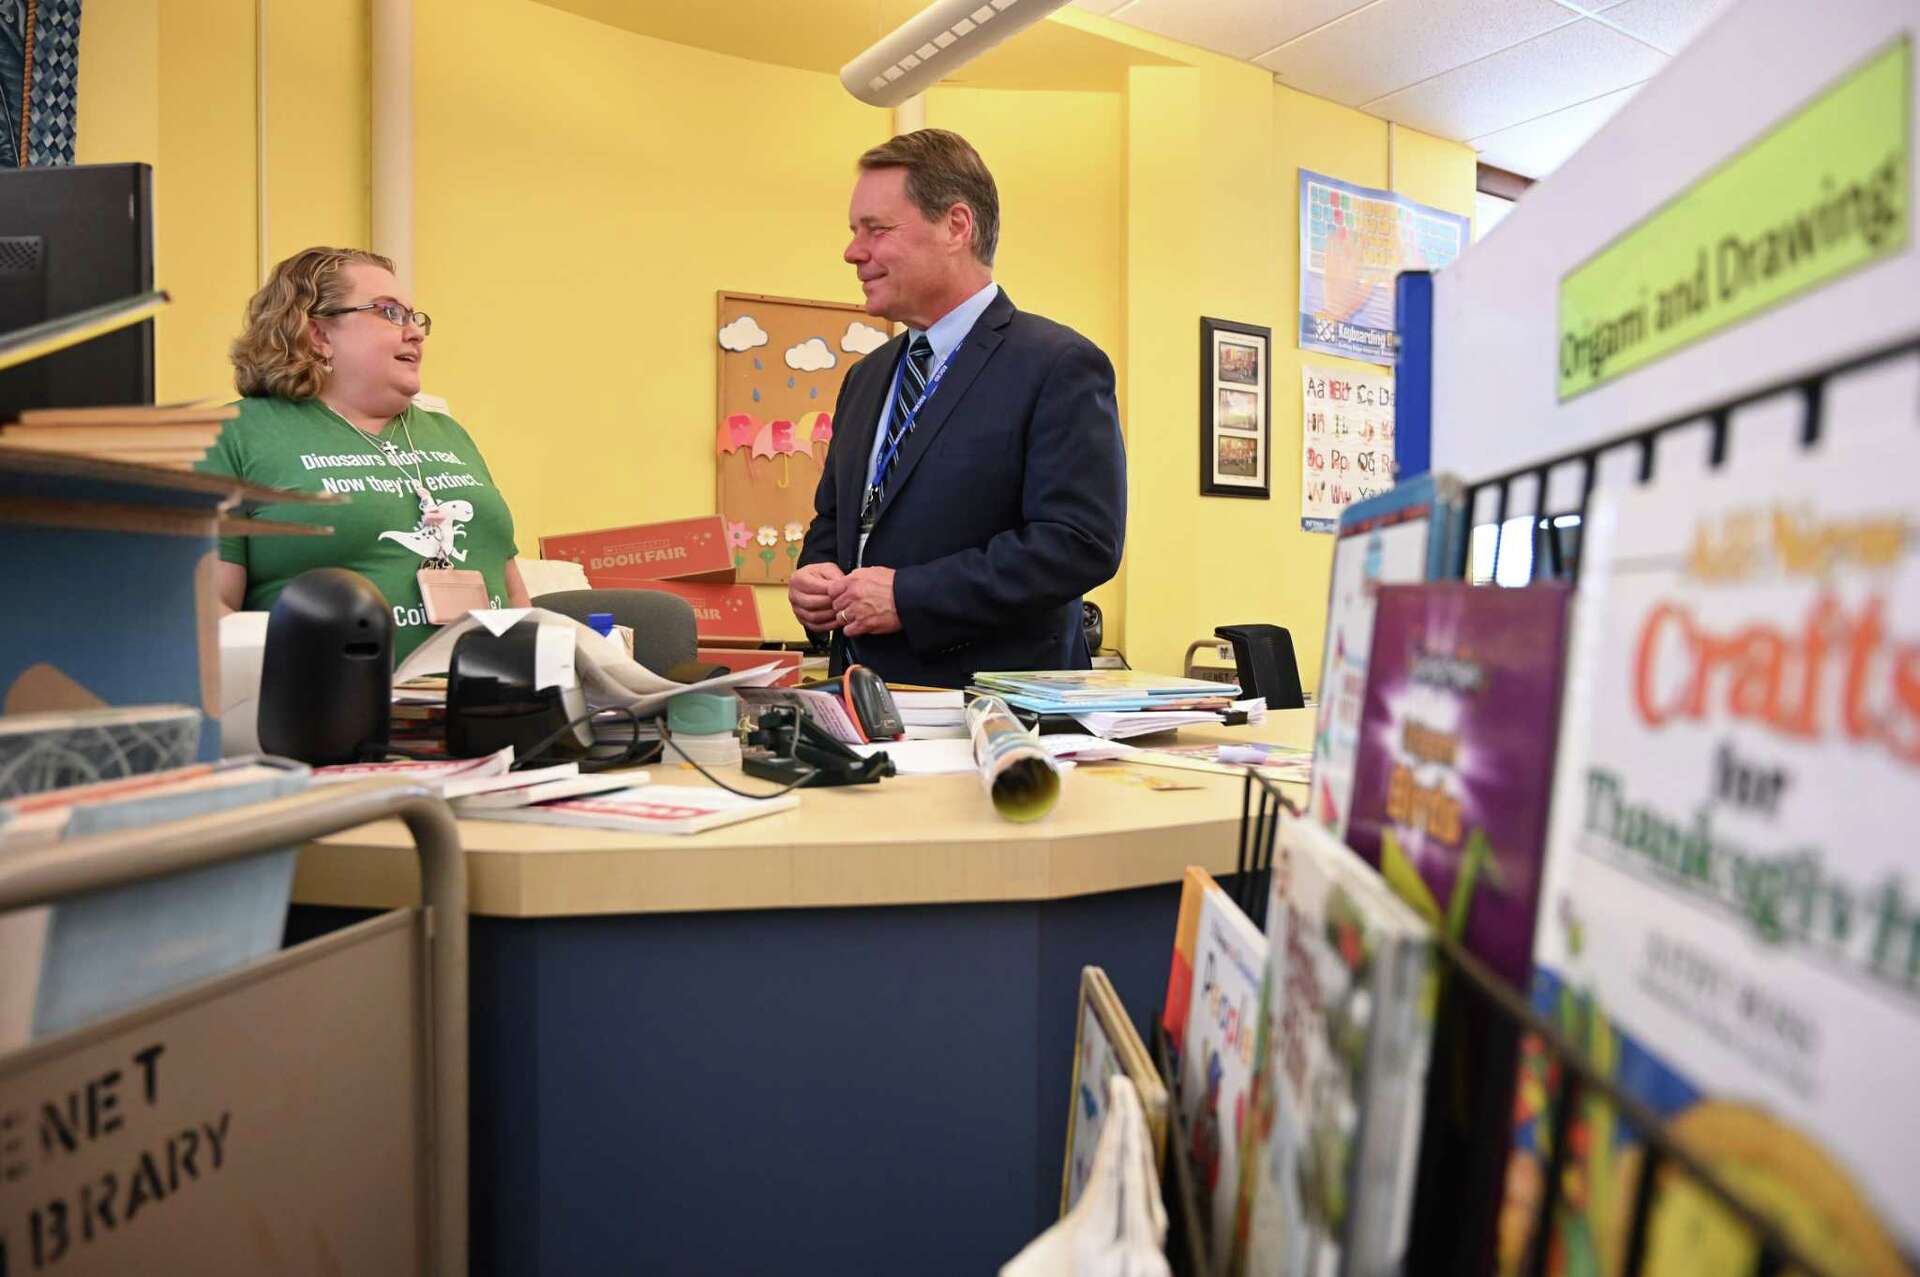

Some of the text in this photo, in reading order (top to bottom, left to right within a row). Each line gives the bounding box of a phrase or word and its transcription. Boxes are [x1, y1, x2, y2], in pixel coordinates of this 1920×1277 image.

[1559, 149, 1900, 380] Origami and Drawing
[300, 452, 386, 471] Dinosaurs
[385, 449, 432, 467] didn't
[321, 477, 366, 495] Now
[425, 471, 484, 492] extinct.
[590, 552, 642, 570] BOOK
[644, 546, 687, 563] FAIR
[694, 608, 721, 621] AIR
